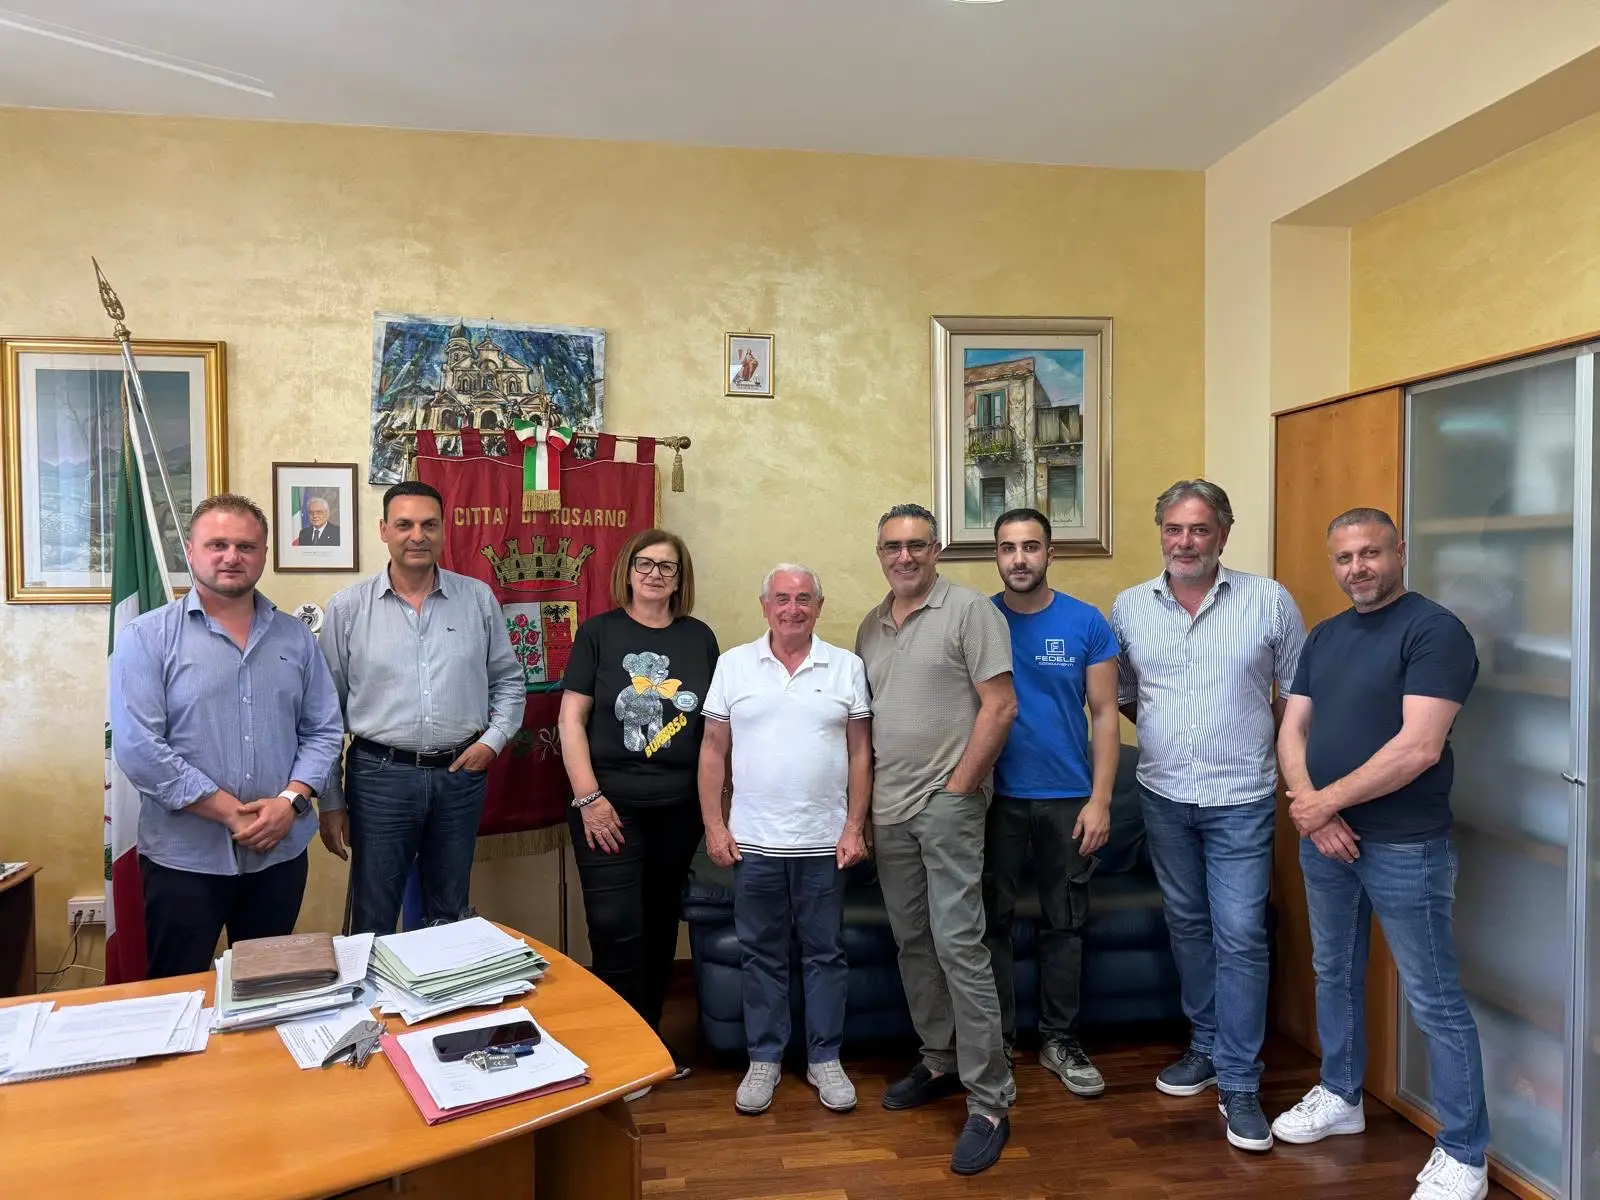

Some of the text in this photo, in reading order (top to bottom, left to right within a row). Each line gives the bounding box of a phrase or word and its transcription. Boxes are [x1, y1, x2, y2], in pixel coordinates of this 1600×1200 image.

[454, 507, 627, 528] CITTA' DI ROSARNO
[1035, 655, 1076, 663] FEDELE
